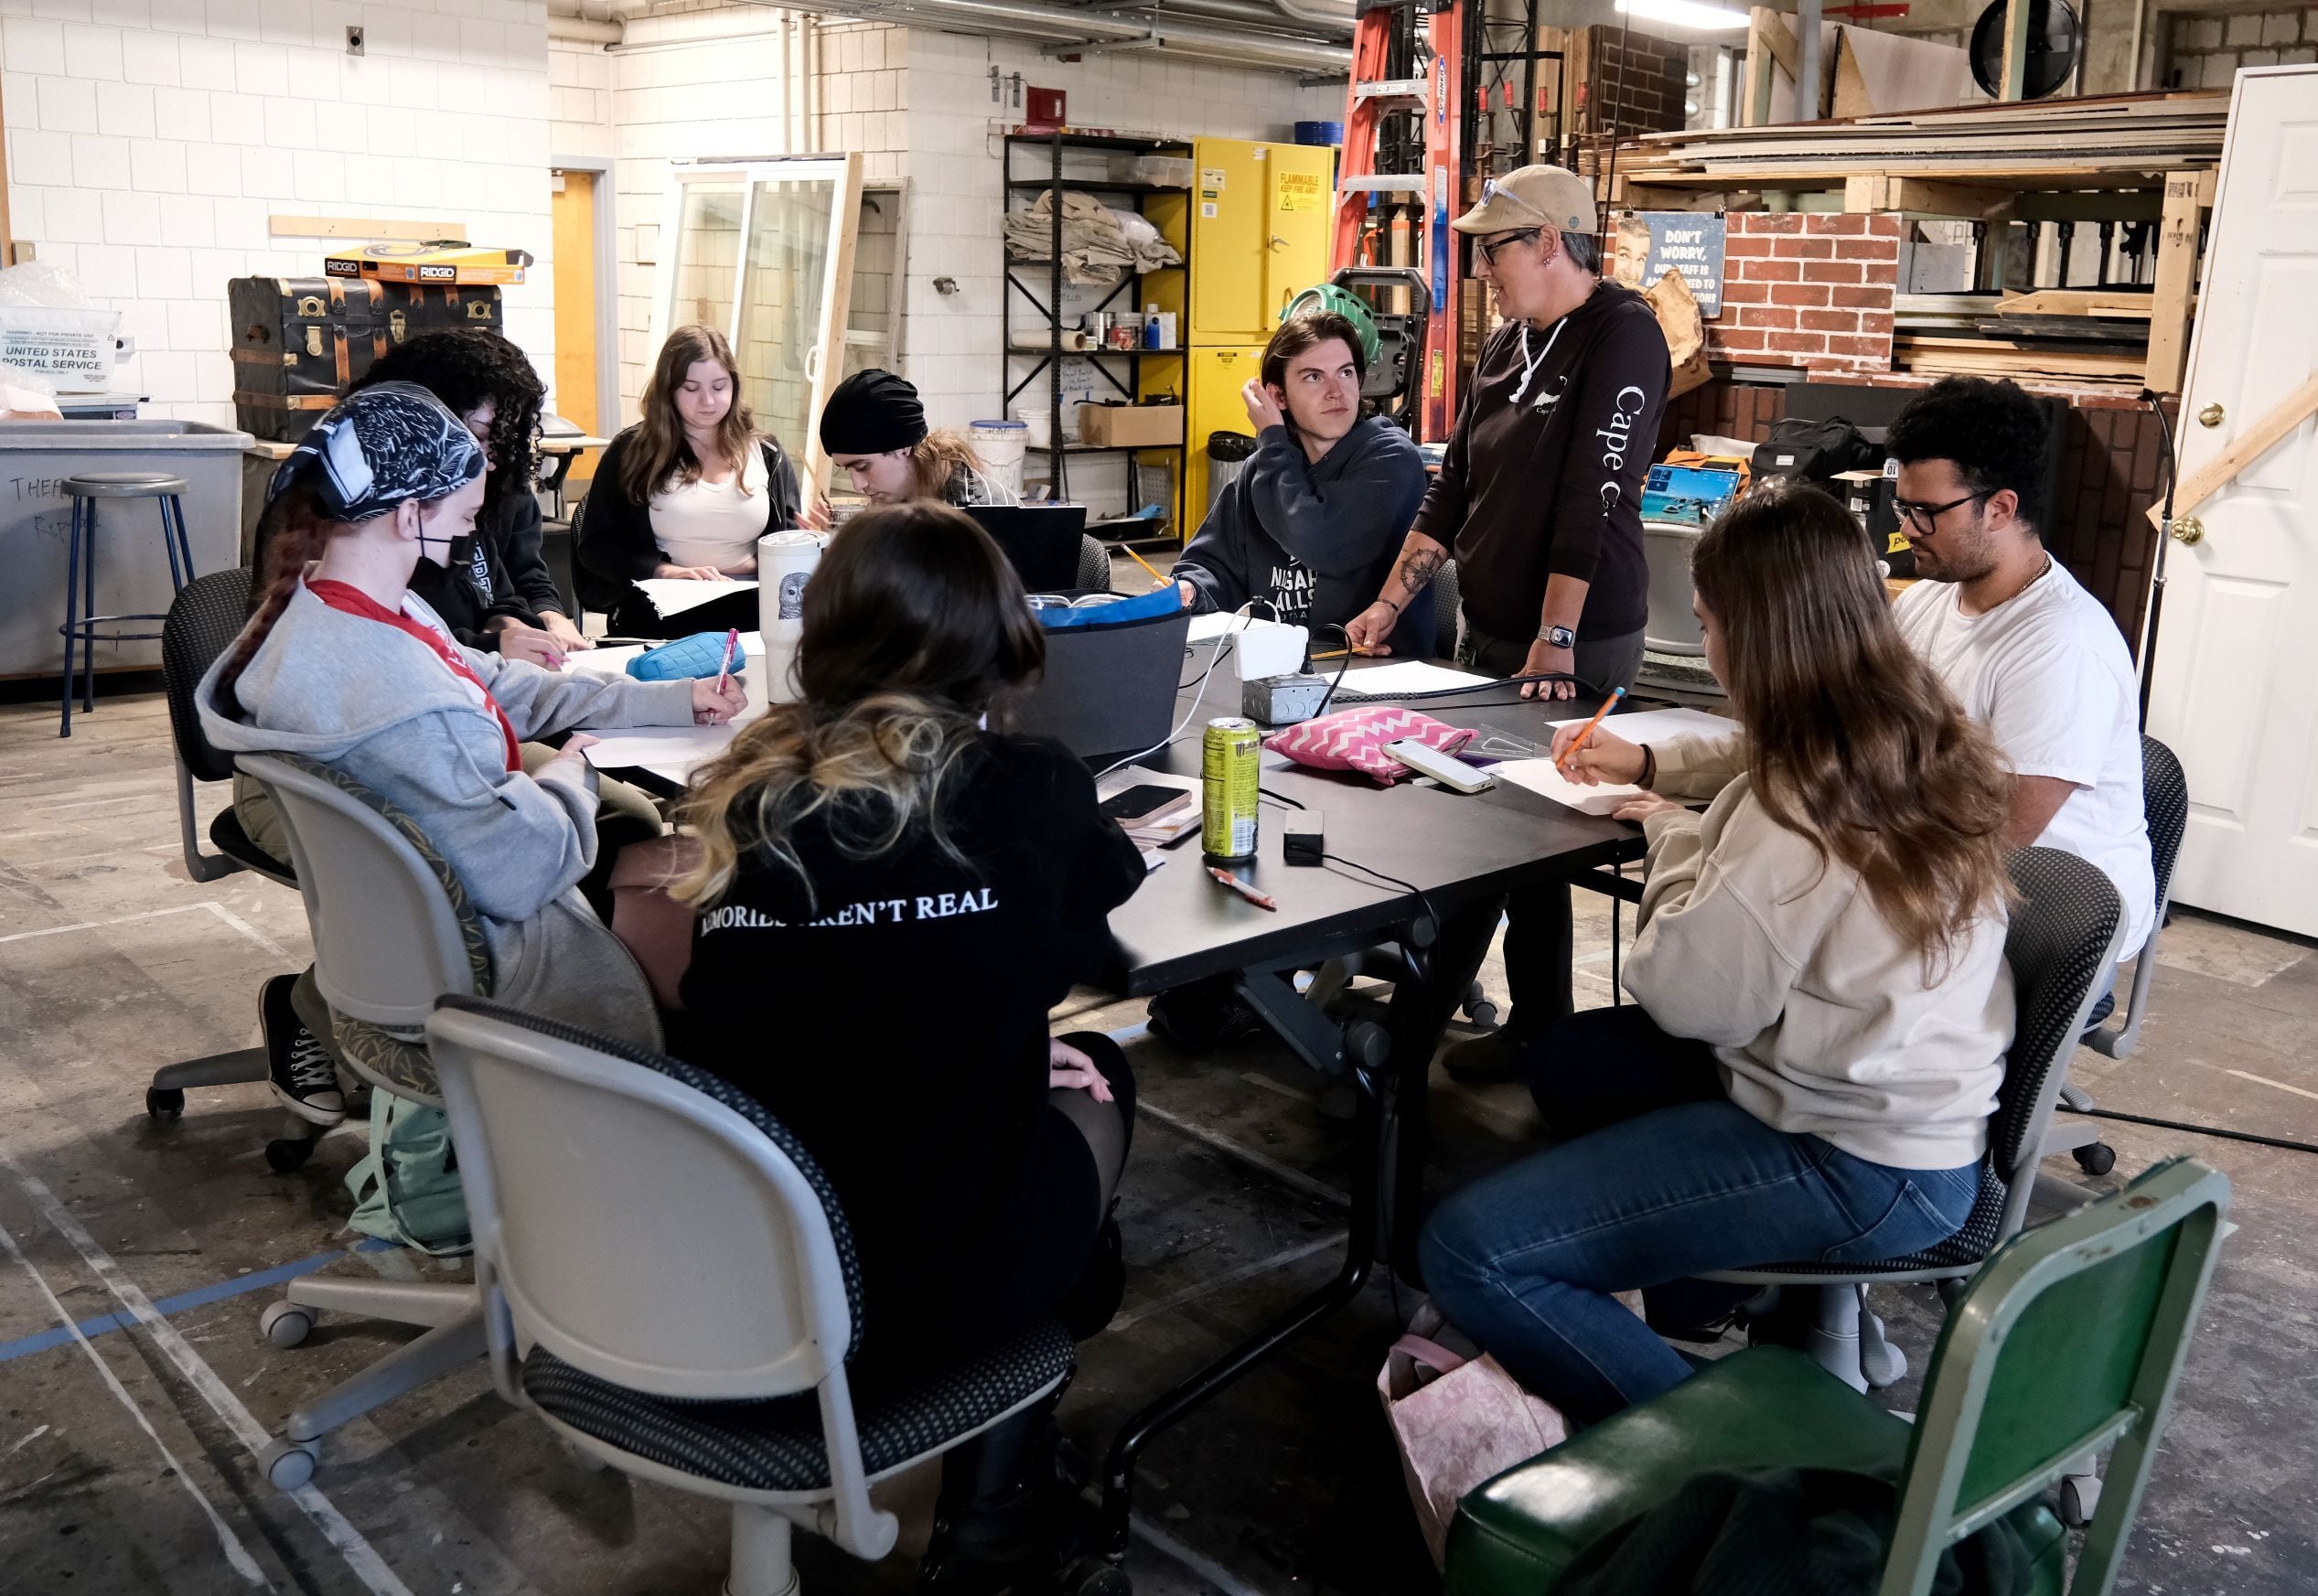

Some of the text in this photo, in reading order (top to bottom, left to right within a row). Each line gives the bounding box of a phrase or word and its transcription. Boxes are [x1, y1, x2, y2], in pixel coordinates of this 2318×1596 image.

[1281, 173, 1319, 186] FLAMMABLE
[1294, 186, 1304, 194] FIRE
[1665, 230, 1702, 244] DON'T
[1660, 246, 1707, 262] WORRY,
[327, 261, 358, 273] RIDGID
[420, 266, 455, 278] RIDGID
[1701, 265, 1710, 275] IS
[1703, 279, 1715, 290] TO
[5, 347, 97, 359] UNITED STATES
[52, 359, 102, 370] SERVICE
[1595, 386, 1645, 471] Cape
[916, 888, 999, 920] REAL
